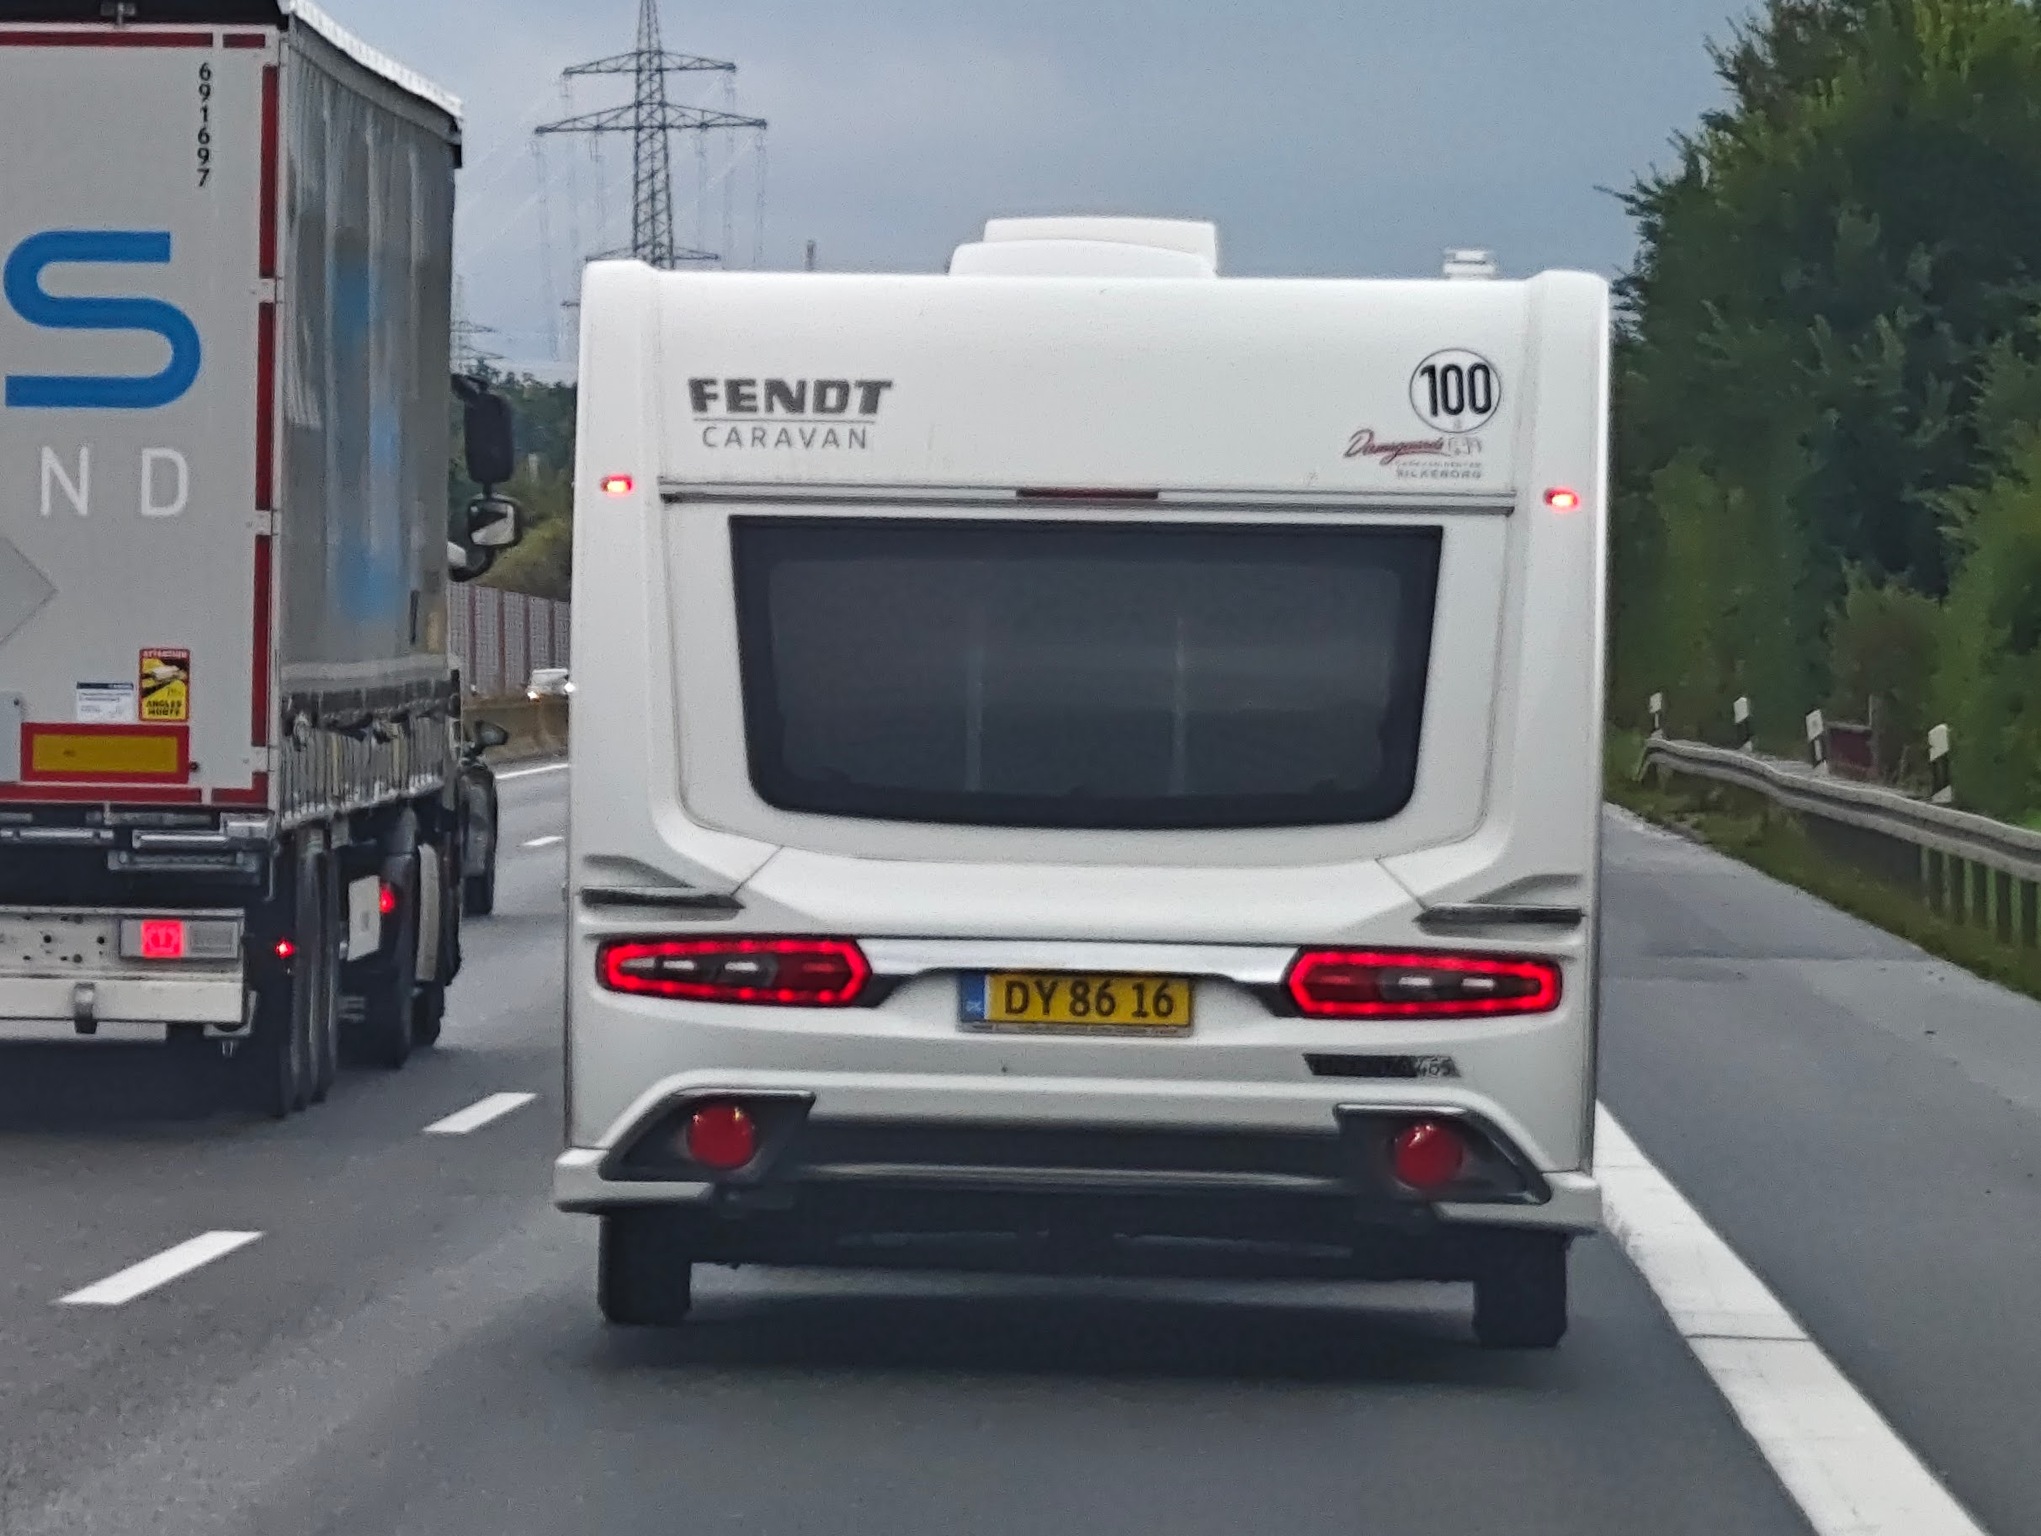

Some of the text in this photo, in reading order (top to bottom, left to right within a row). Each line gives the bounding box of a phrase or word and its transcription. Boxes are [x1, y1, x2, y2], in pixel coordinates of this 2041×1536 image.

[198, 61, 212, 187] 691697
[3, 230, 202, 409] S
[688, 378, 893, 415] FENDT
[1418, 362, 1492, 418] 100
[702, 425, 867, 450] CARAVAN
[1005, 979, 1175, 1019] DY 86 16
